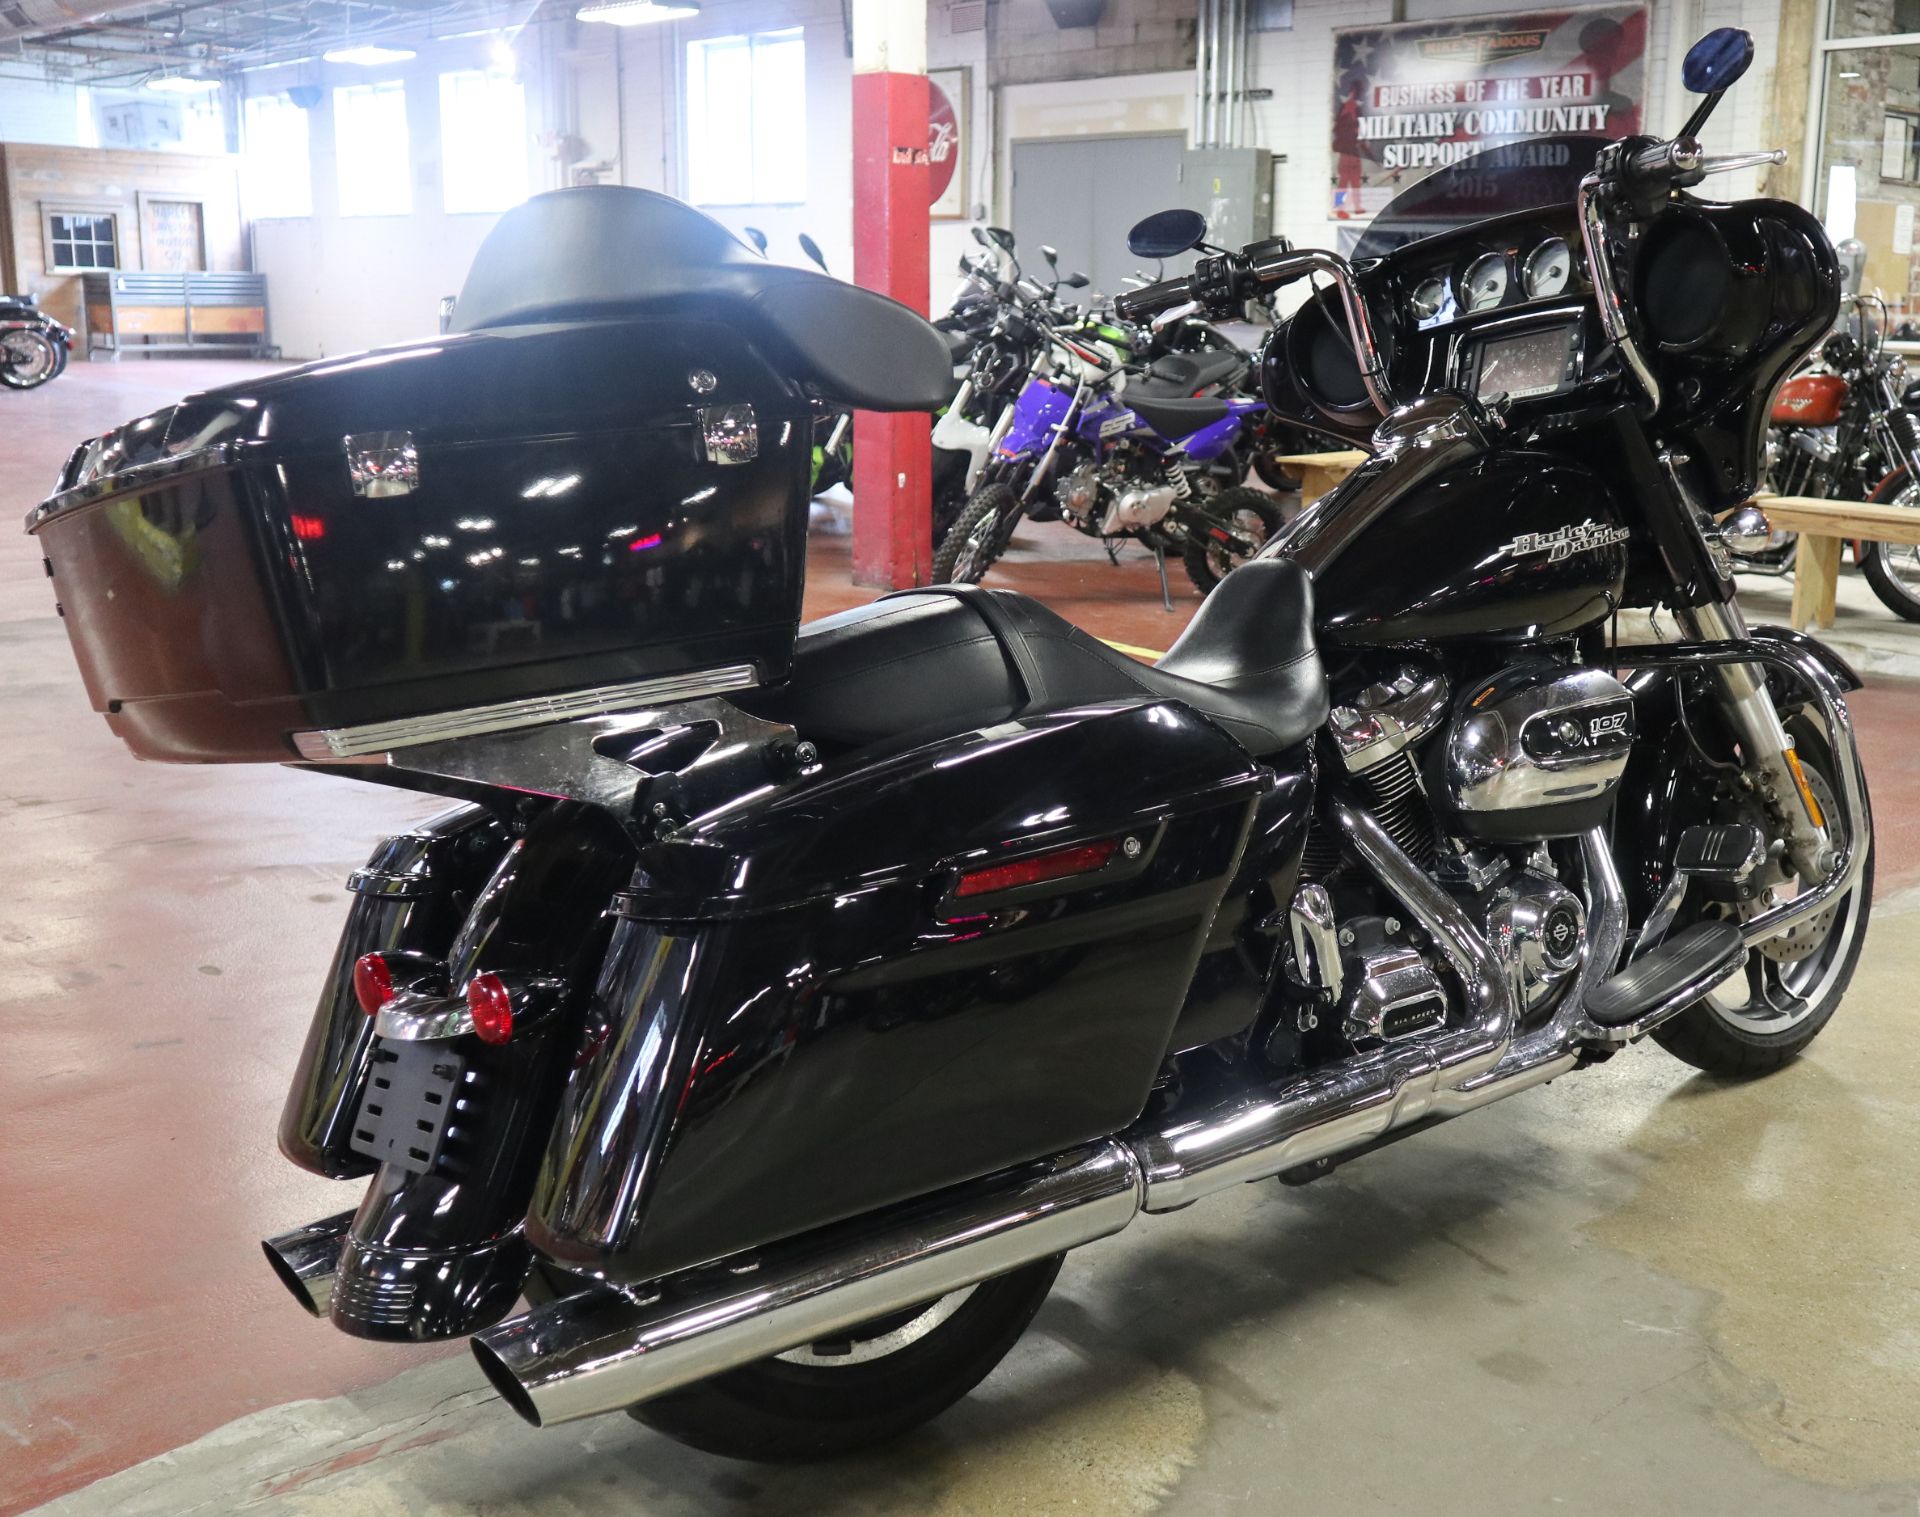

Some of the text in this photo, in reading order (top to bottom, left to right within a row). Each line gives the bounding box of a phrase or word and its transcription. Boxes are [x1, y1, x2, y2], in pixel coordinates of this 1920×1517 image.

[1380, 75, 1585, 107] BUSINESS OF THE YEAR
[1357, 104, 1610, 139] MILITARY COMMUNITY
[1383, 141, 1570, 169] SUPPORT AWARD
[1446, 174, 1498, 199] 2015
[1099, 411, 1136, 438] SSR
[1590, 712, 1628, 733] 107
